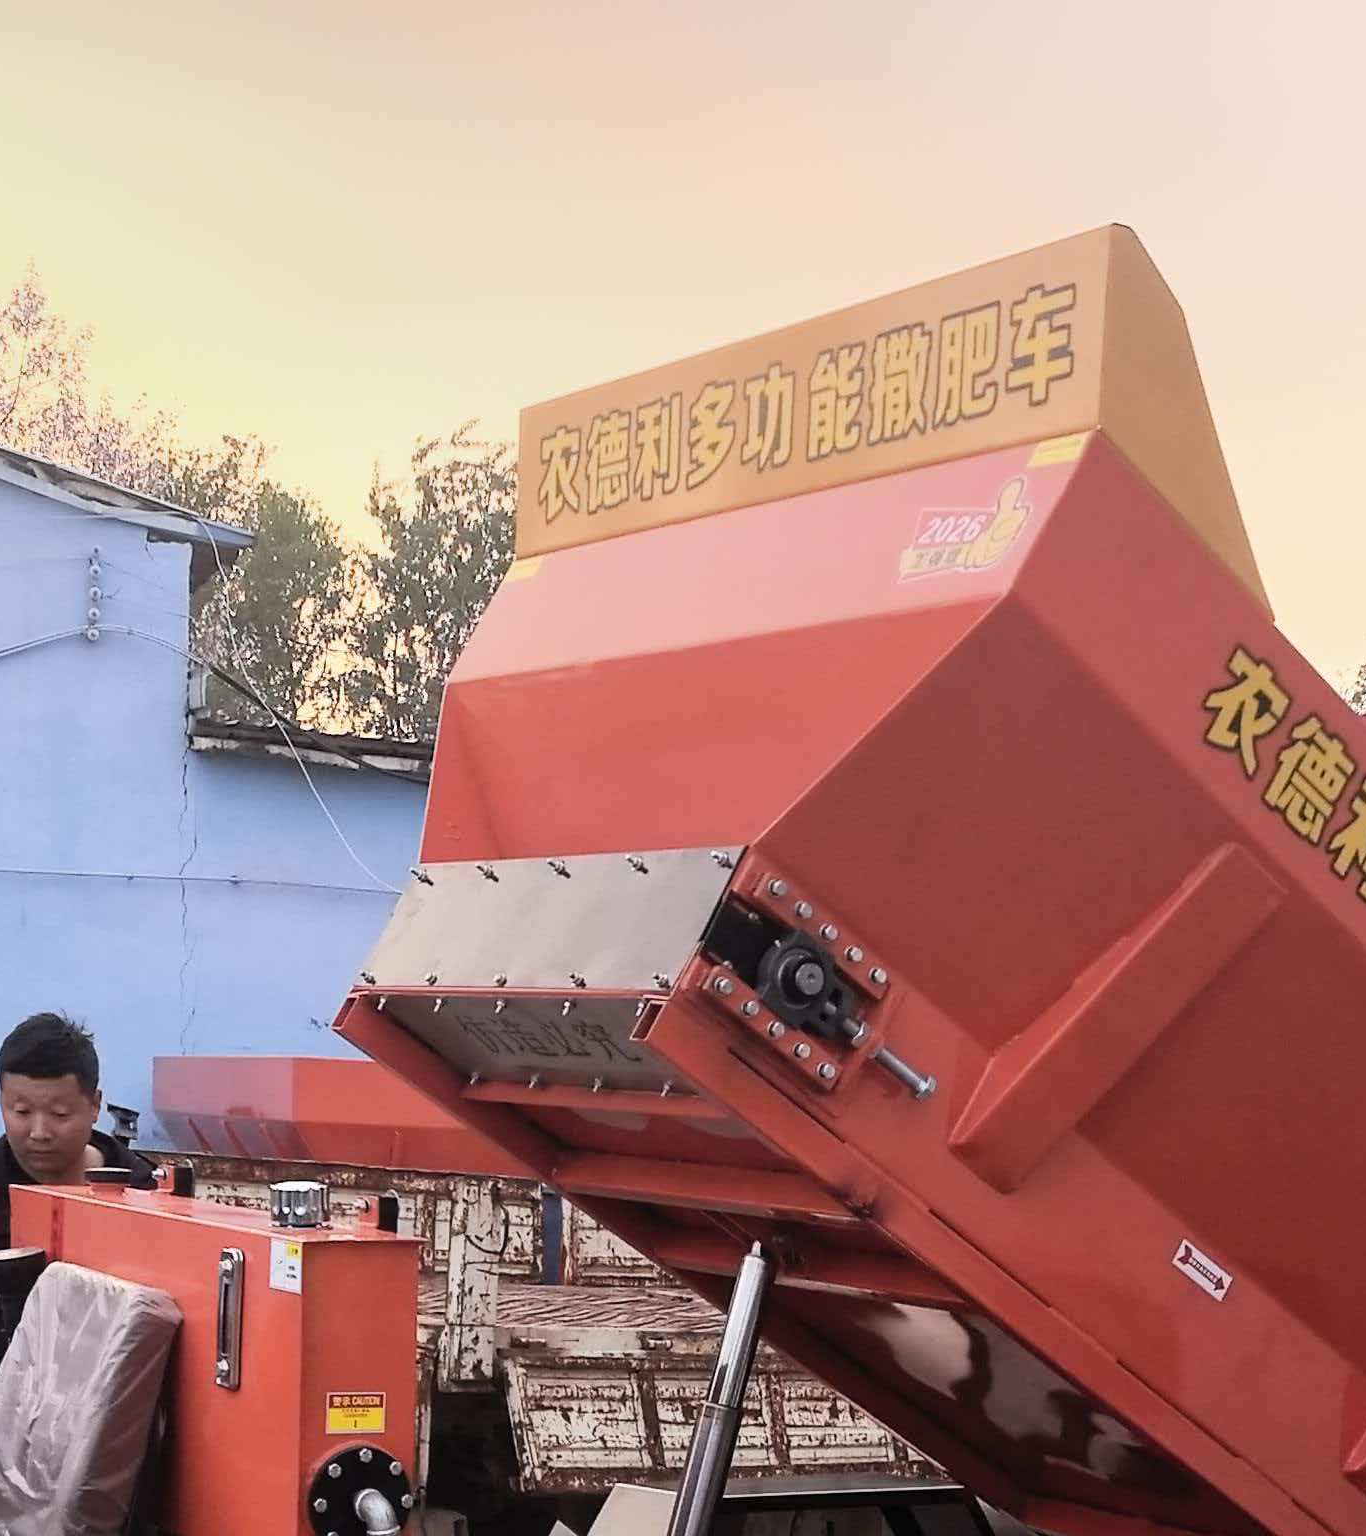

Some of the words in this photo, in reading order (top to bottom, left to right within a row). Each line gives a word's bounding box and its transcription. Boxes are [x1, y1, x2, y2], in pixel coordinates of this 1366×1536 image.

[538, 283, 1077, 524] 农德利多功能撒肥车
[916, 513, 987, 545] 2026
